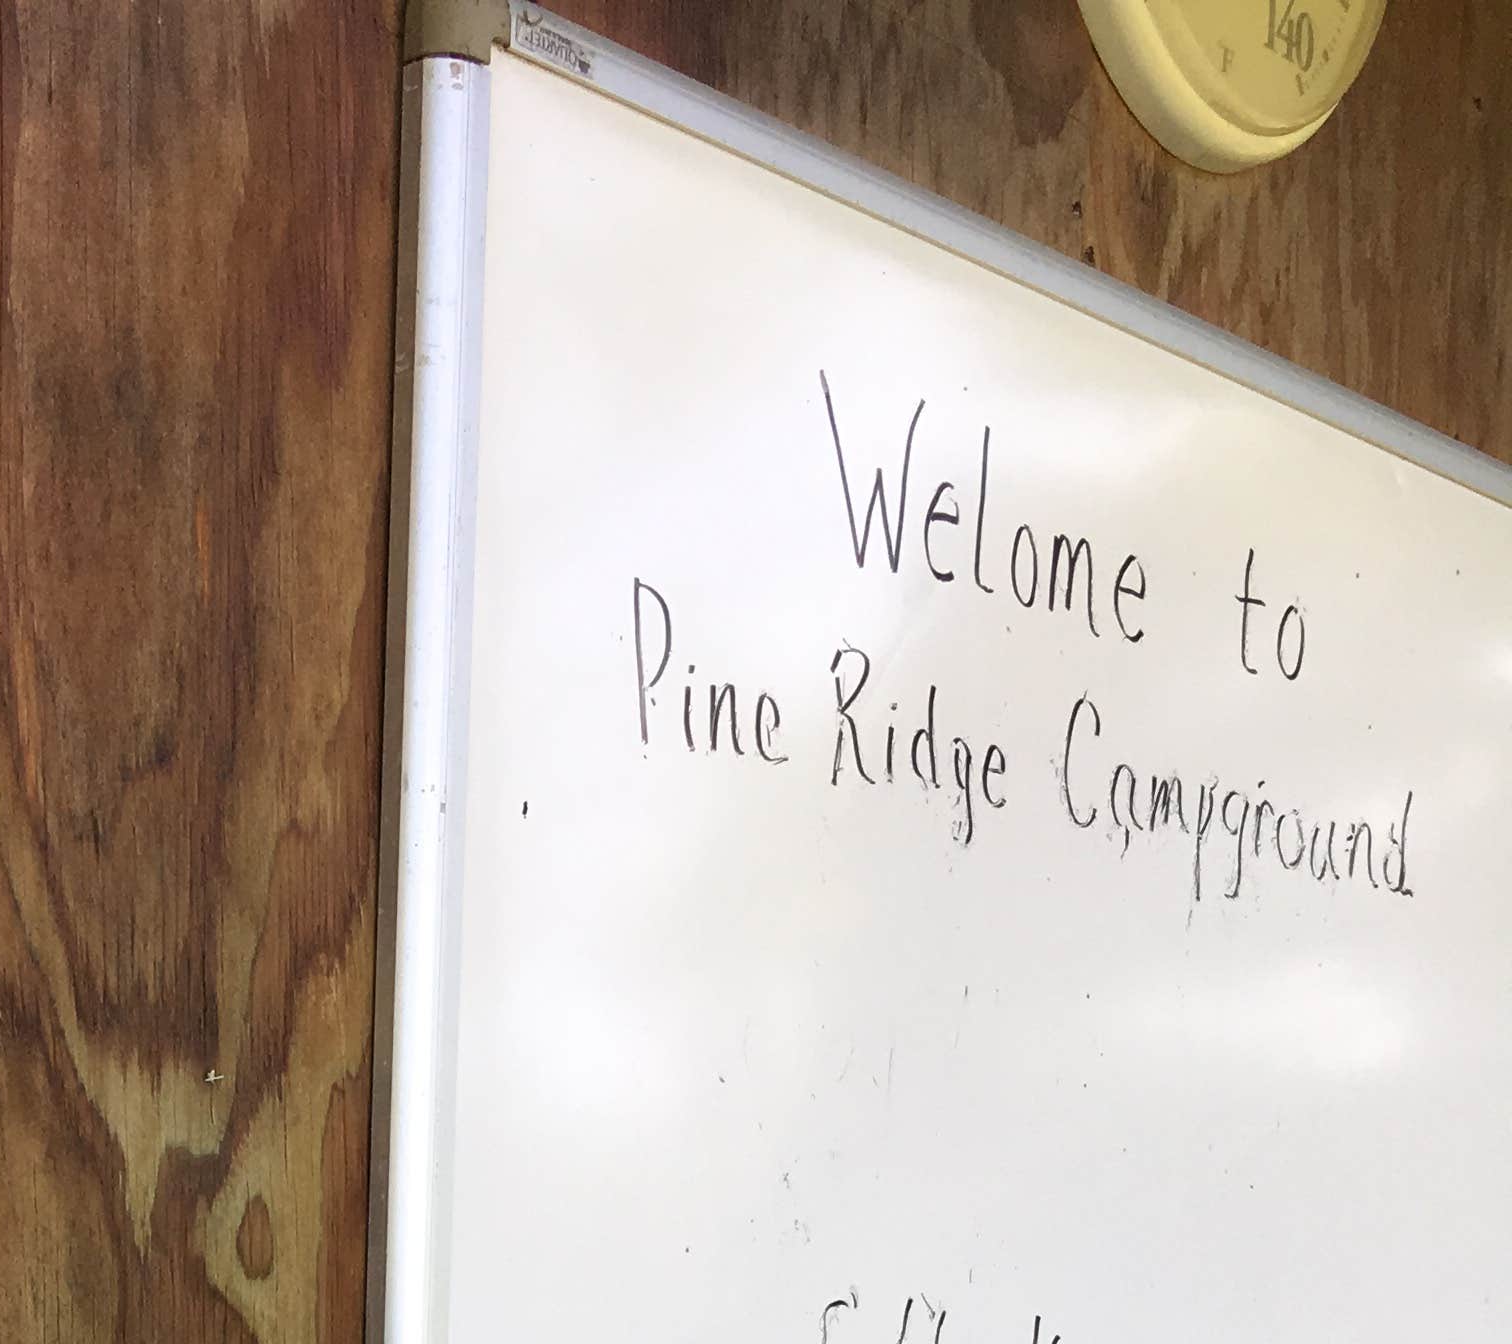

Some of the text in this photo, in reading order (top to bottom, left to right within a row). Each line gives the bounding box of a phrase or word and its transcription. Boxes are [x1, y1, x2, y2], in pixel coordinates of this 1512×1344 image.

[820, 370, 1306, 680] Welome to
[633, 577, 1414, 900] Pine Ridge Campground
